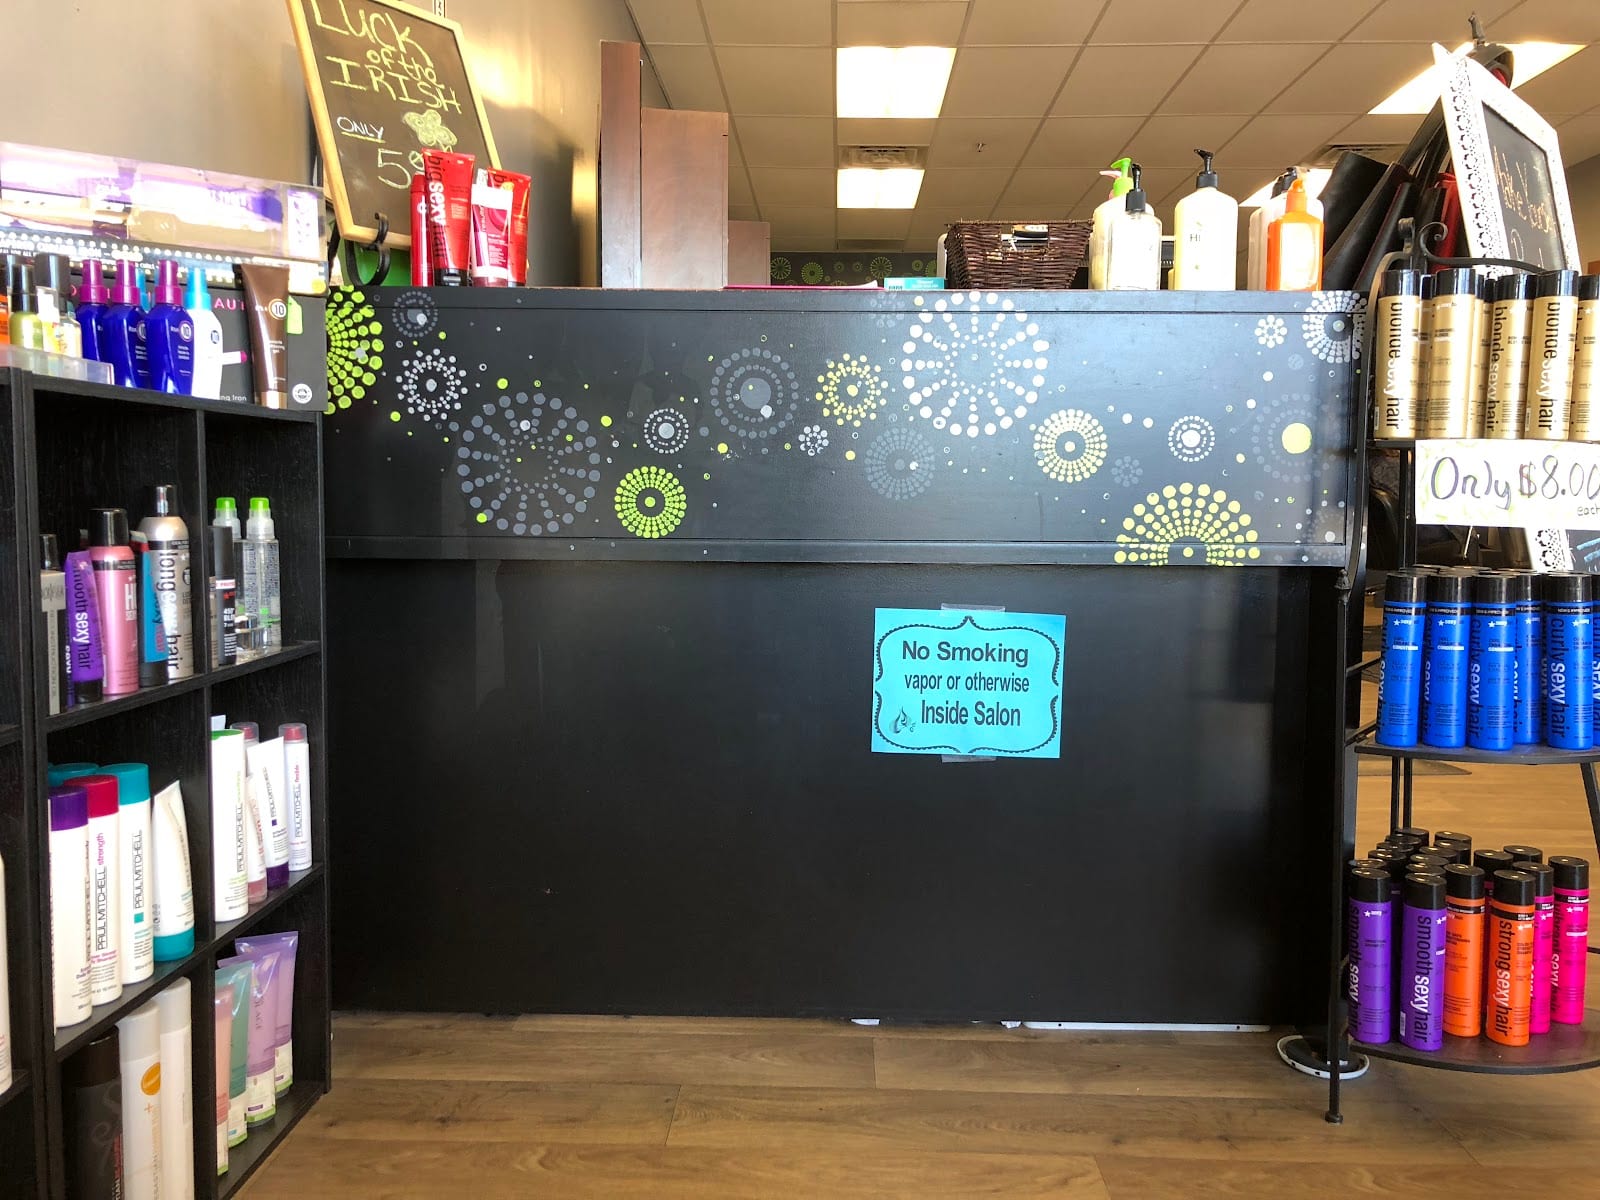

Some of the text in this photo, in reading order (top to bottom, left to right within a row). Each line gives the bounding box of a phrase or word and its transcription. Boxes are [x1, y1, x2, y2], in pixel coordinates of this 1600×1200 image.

[326, 55, 462, 114] IRISH
[366, 49, 394, 68] of
[337, 116, 385, 138] ONLY
[1486, 306, 1508, 431] blondesexyhair
[1431, 455, 1600, 510] Only $8.00
[902, 641, 1029, 668] No Smoking
[1549, 619, 1570, 738] curlysexyhair
[904, 672, 1030, 694] vapor or otherwise
[921, 700, 1021, 726] Inside Salon
[97, 868, 107, 920] MITCHELL
[133, 832, 143, 909] PAUL MITCHELL
[97, 922, 107, 951] PAUL
[1410, 915, 1433, 1042] smoothsexyhair
[1493, 920, 1515, 1036] strongsexyhair
